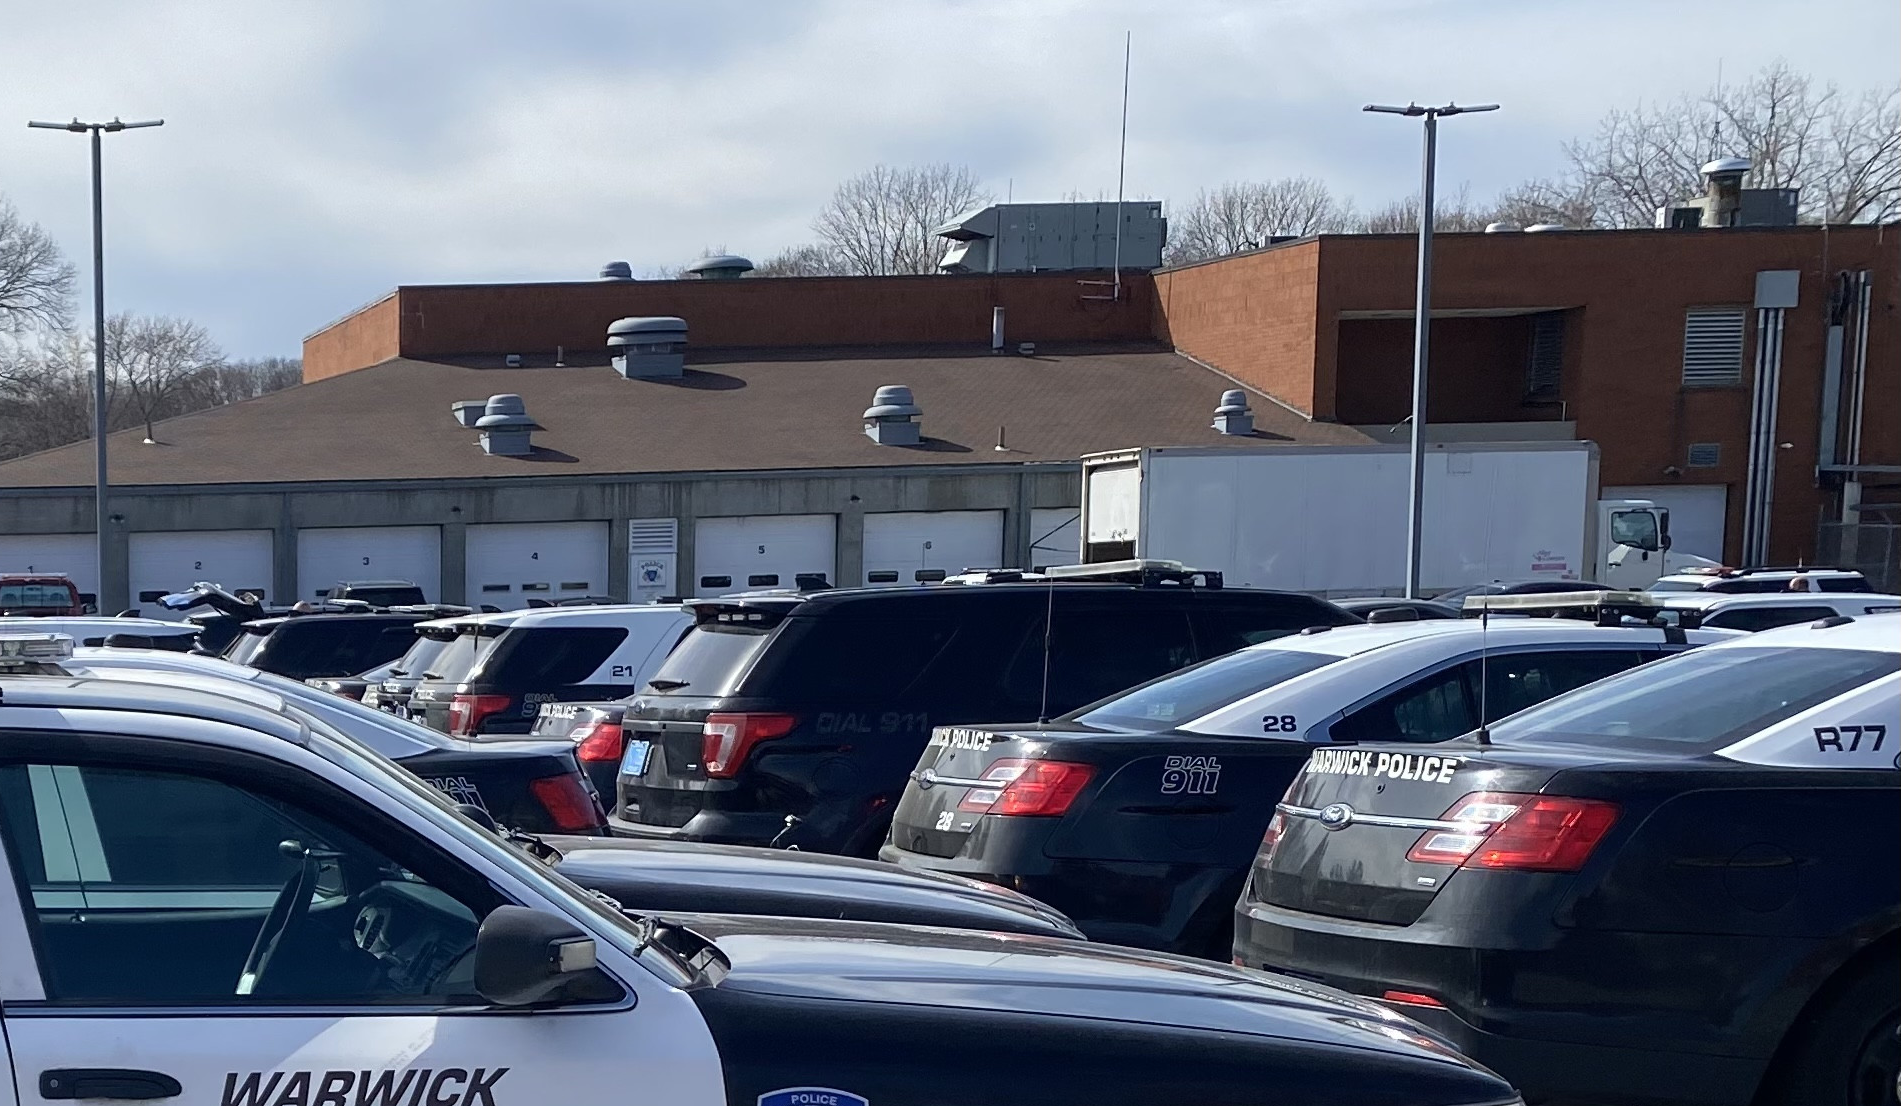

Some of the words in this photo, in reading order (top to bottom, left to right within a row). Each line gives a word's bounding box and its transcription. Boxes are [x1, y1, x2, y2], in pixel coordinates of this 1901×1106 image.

[531, 552, 538, 560] 4
[758, 545, 765, 554] 5
[194, 561, 202, 570] 2
[363, 557, 369, 565] 3
[612, 665, 633, 677] 21
[524, 693, 558, 702] DIAL
[817, 711, 872, 734] DIAL
[880, 711, 928, 733] 911
[1262, 715, 1297, 733] 28
[950, 729, 994, 752] POLICE
[1813, 724, 1887, 752] R77
[1164, 755, 1222, 771] DIAL
[1306, 750, 1373, 776] WARWICK
[1373, 752, 1458, 784] POLICE
[1161, 768, 1220, 794] 911
[935, 811, 955, 831] 28
[790, 1093, 838, 1106] POLICE
